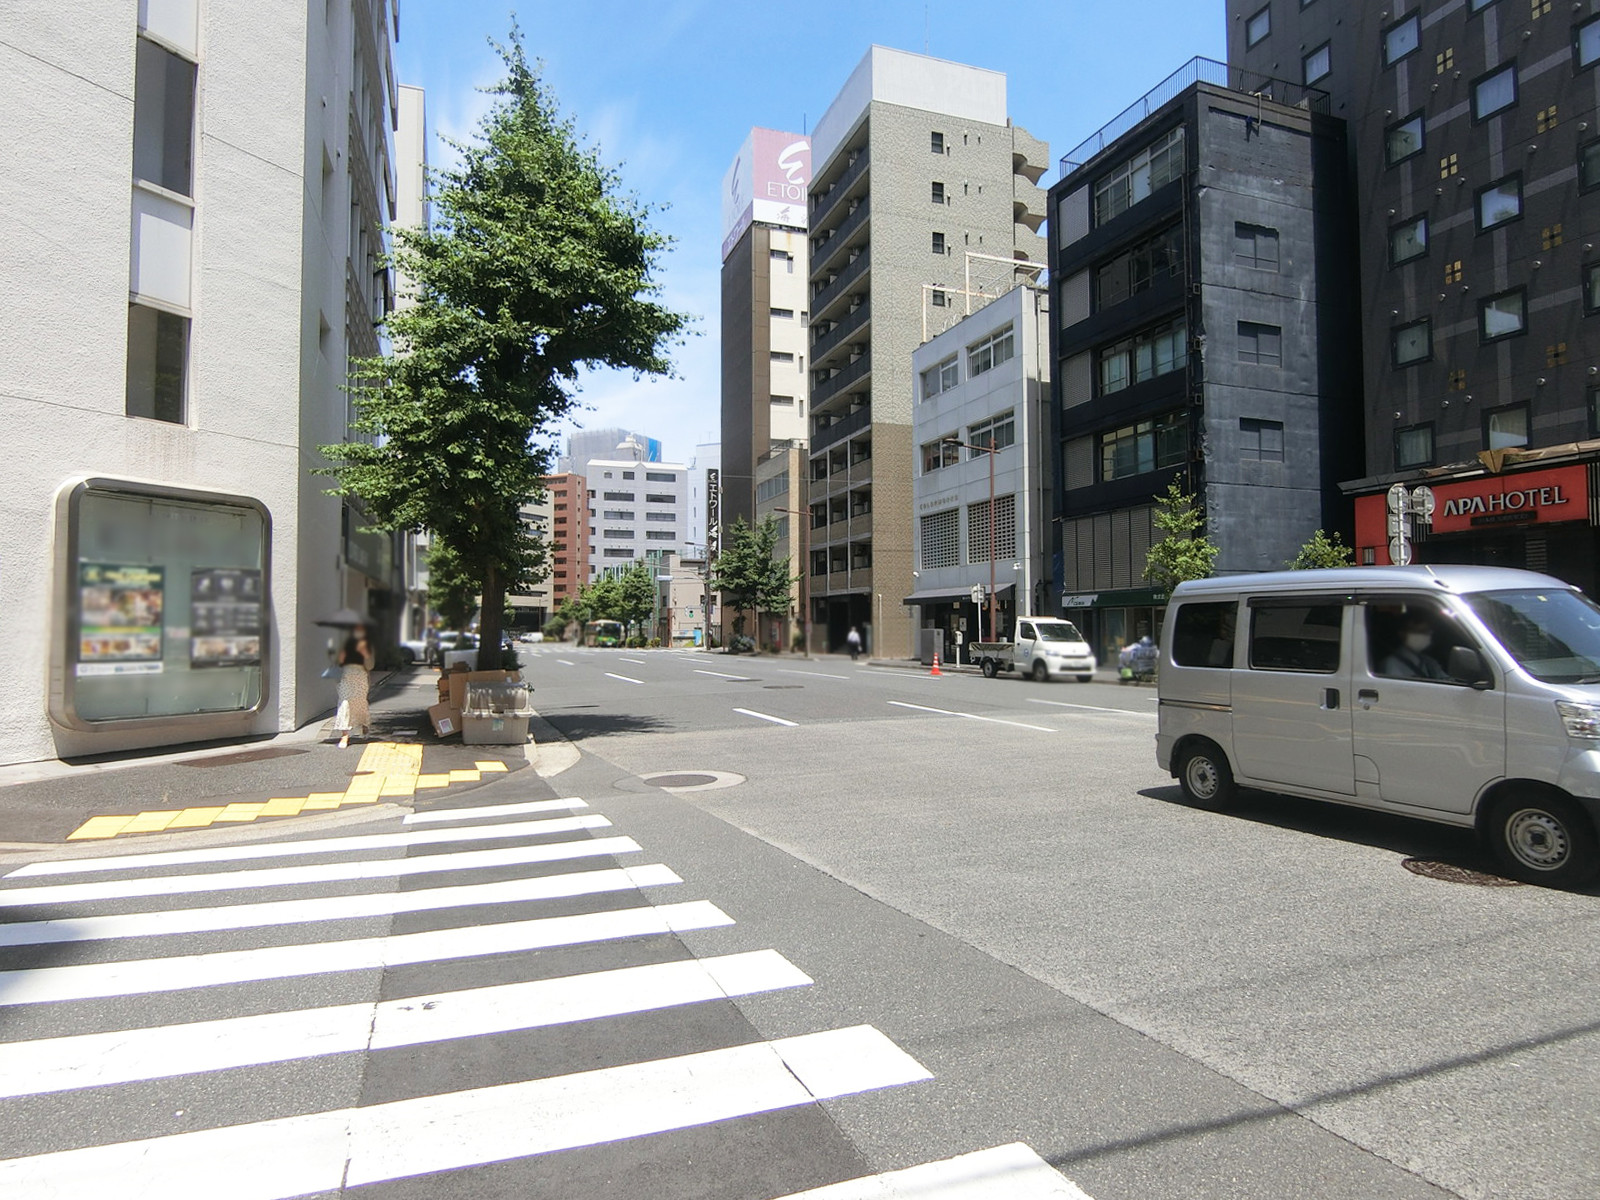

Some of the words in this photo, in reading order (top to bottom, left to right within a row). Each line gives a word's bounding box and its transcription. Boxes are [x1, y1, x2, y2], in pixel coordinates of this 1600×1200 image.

[709, 484, 718, 526] エトワール
[1443, 496, 1486, 516] APA
[1488, 486, 1567, 511] HOTEL
